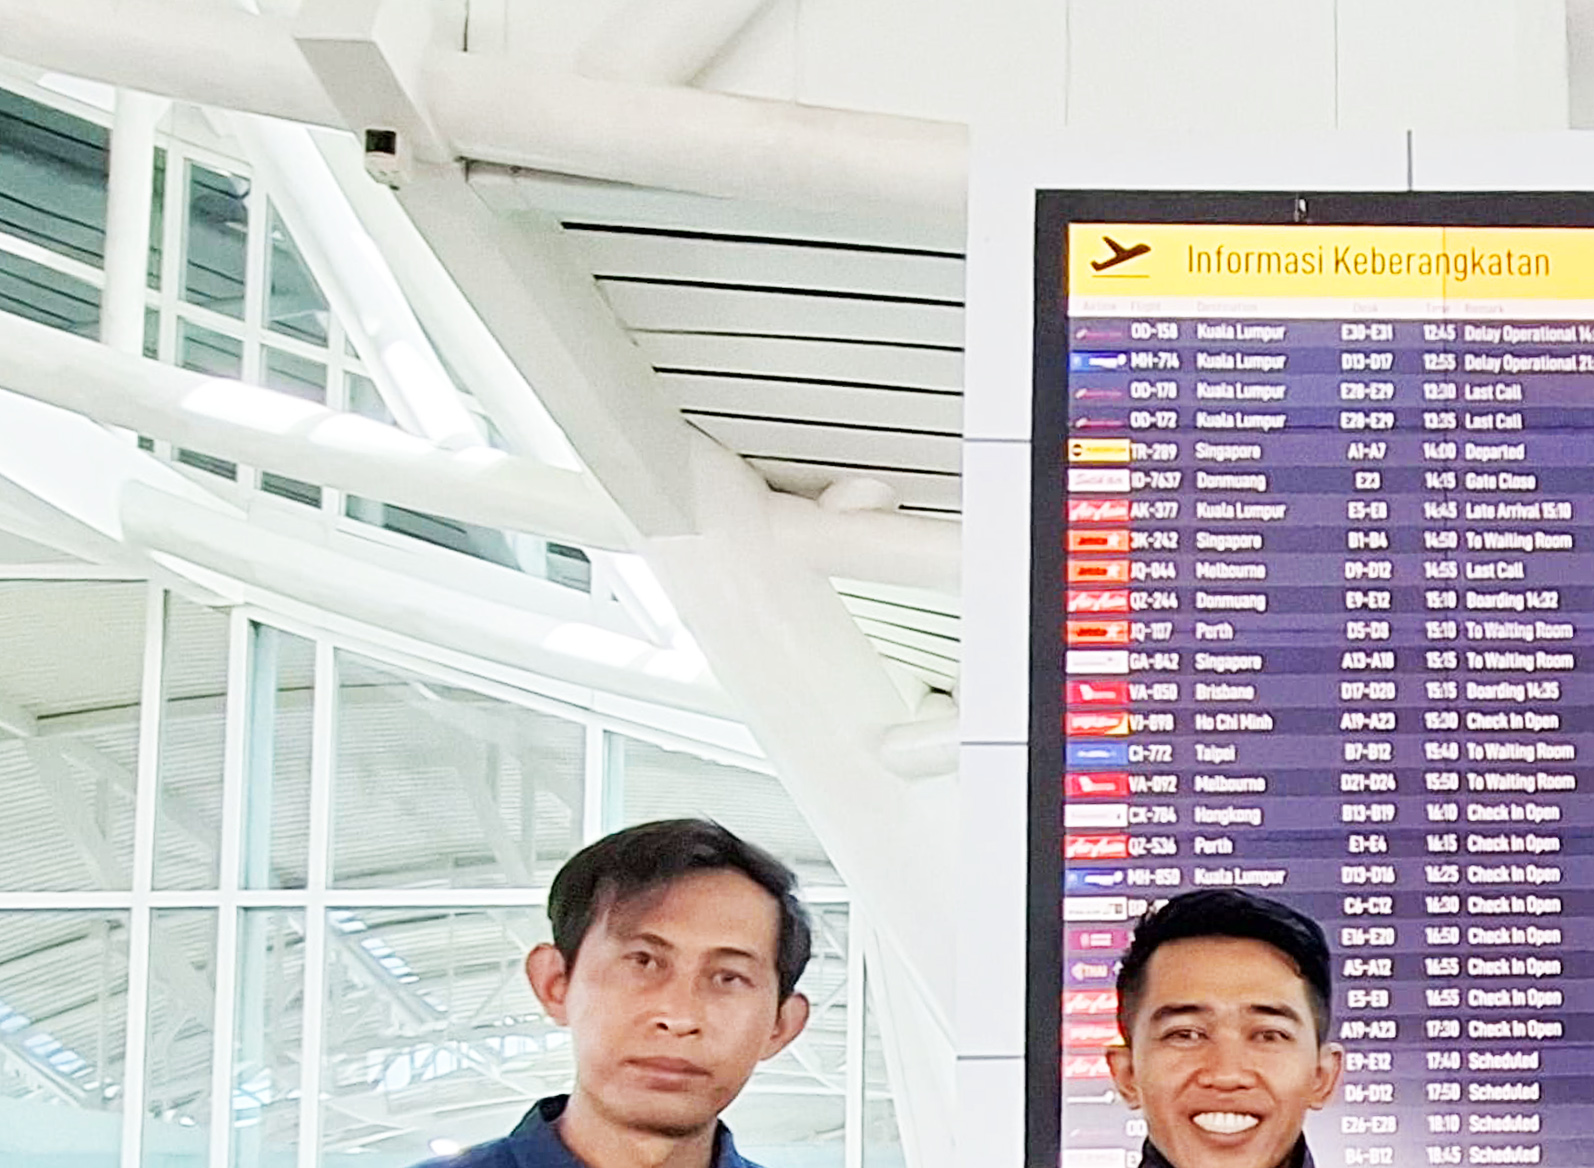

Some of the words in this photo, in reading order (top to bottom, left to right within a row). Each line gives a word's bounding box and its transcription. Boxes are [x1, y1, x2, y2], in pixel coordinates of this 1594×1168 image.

[1187, 244, 1323, 275] Informasi
[1334, 246, 1550, 282] Keberangkatan
[1197, 323, 1235, 339] Kuala
[1236, 323, 1285, 342] Lumpur
[1464, 325, 1501, 344] Delay
[1503, 325, 1577, 343] Operational
[1197, 352, 1235, 369] Kuala
[1236, 352, 1286, 371] Lumpur
[1464, 354, 1502, 373] Delay
[1502, 354, 1578, 373] Operational
[1197, 382, 1235, 399] Kuala
[1235, 382, 1286, 401] Lumpur
[1465, 384, 1494, 400] Last
[1495, 383, 1522, 400] Call
[1196, 411, 1235, 428] Kuala
[1235, 412, 1286, 431] Lumpur
[1465, 413, 1494, 429] Last
[1495, 412, 1522, 429] Call
[1195, 442, 1261, 462] Singapore
[1465, 443, 1525, 462] Departed
[1196, 471, 1266, 492] Donmuang
[1465, 472, 1497, 489] Gate
[1498, 472, 1536, 489] Close
[1196, 502, 1235, 519] Kuala
[1235, 502, 1286, 521] Lumpur
[1465, 502, 1496, 519] Late
[1496, 502, 1541, 519] Arrival
[1541, 502, 1572, 519] 15:10
[1196, 531, 1262, 551] Singapore
[1465, 531, 1483, 549] To
[1483, 532, 1534, 552] Waiting
[1534, 531, 1573, 549] Room
[1196, 562, 1266, 579] Melbourne
[1466, 562, 1495, 579] Last
[1497, 561, 1524, 579] Call
[1196, 591, 1266, 612] Donmuang
[1466, 591, 1525, 611] Boarding
[1525, 591, 1558, 609] 14:32
[1196, 622, 1233, 639] Perth
[1465, 621, 1483, 639] To
[1484, 621, 1534, 642] Waiting
[1535, 621, 1574, 639] Room
[1195, 652, 1262, 672] Singapore
[1466, 651, 1484, 669] To
[1484, 651, 1535, 672] Waiting
[1535, 651, 1574, 669] Room
[1195, 683, 1254, 700] Brisbane
[1425, 681, 1457, 699] 15:15
[1466, 682, 1525, 702] Boarding
[1195, 714, 1215, 730] Ho
[1215, 713, 1239, 731] Chi
[1239, 713, 1273, 730] Minh
[1466, 712, 1509, 730] Check
[1524, 711, 1559, 731] Open
[1195, 744, 1235, 763] Taipei
[1466, 742, 1484, 760] To
[1484, 743, 1535, 763] Waiting
[1536, 742, 1575, 760] Room
[1194, 775, 1266, 792] Melbourne
[1467, 772, 1485, 791] To
[1485, 773, 1536, 793] Waiting
[1536, 772, 1576, 790] Room
[1194, 806, 1261, 826] Hongkong
[1467, 803, 1510, 821] Check
[1525, 803, 1560, 823] Open
[1194, 836, 1233, 854] Perth
[1467, 834, 1510, 852] Check
[1525, 833, 1560, 854] Open
[1194, 868, 1233, 885] Kuala
[1234, 867, 1286, 887] Lumpur
[1467, 865, 1510, 883] Check
[1525, 864, 1561, 885] Open
[1467, 896, 1510, 914] Check
[1526, 895, 1561, 915] Open
[1467, 927, 1511, 945] Check
[1526, 926, 1561, 946] Open
[1467, 957, 1511, 975] Check
[1526, 957, 1561, 977] Open
[1468, 989, 1511, 1007] Check
[1526, 988, 1562, 1008] Open
[1468, 1020, 1511, 1038] Check
[1527, 1019, 1562, 1039] Open
[1426, 1051, 1461, 1070] 17:40
[1468, 1051, 1539, 1070] Scheduled
[1426, 1082, 1461, 1101] 17:50
[1468, 1082, 1540, 1101] Scheduled
[1469, 1114, 1540, 1132] Scheduled
[1469, 1146, 1540, 1164] Scheduled
